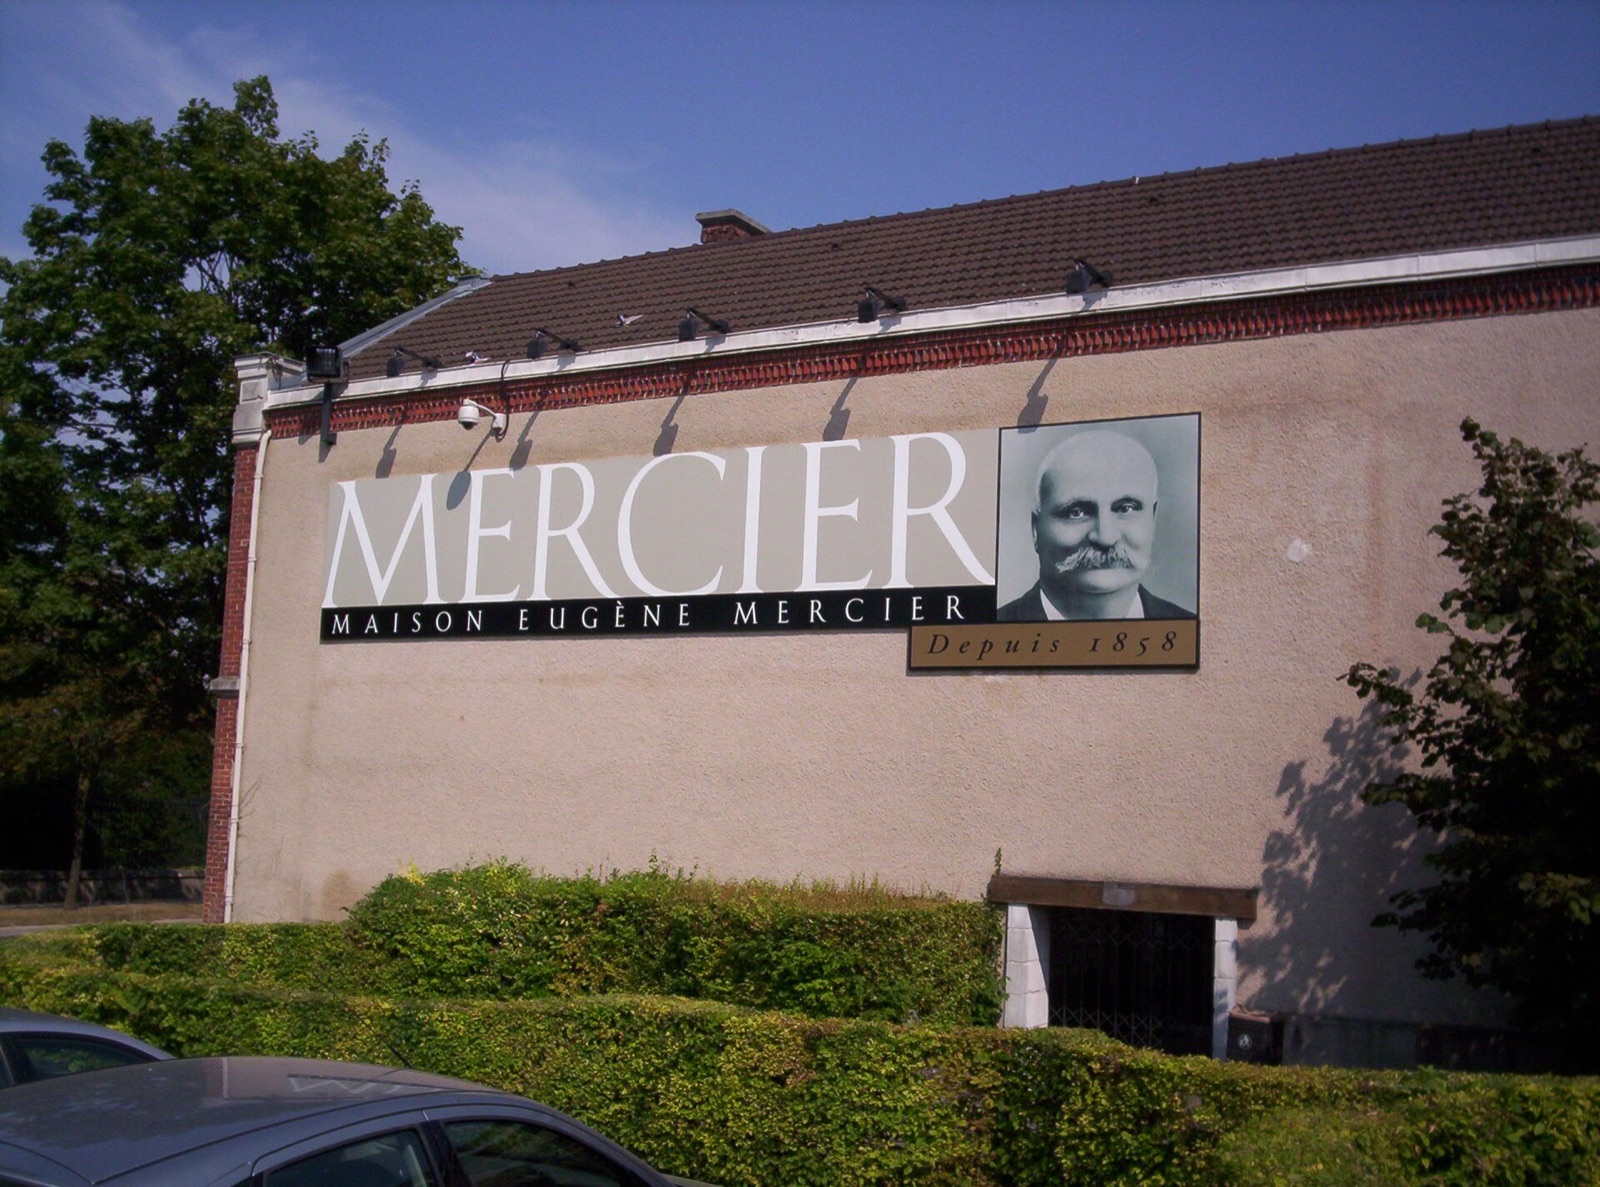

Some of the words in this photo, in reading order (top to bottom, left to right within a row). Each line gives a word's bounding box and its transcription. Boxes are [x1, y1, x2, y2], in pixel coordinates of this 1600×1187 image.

[322, 432, 996, 608] MERCIER
[331, 609, 485, 635] MAISON
[518, 600, 691, 631] EUGÈNE
[733, 595, 965, 625] MERCIER
[926, 633, 1061, 660] Depuis
[1088, 630, 1178, 656] 1858
